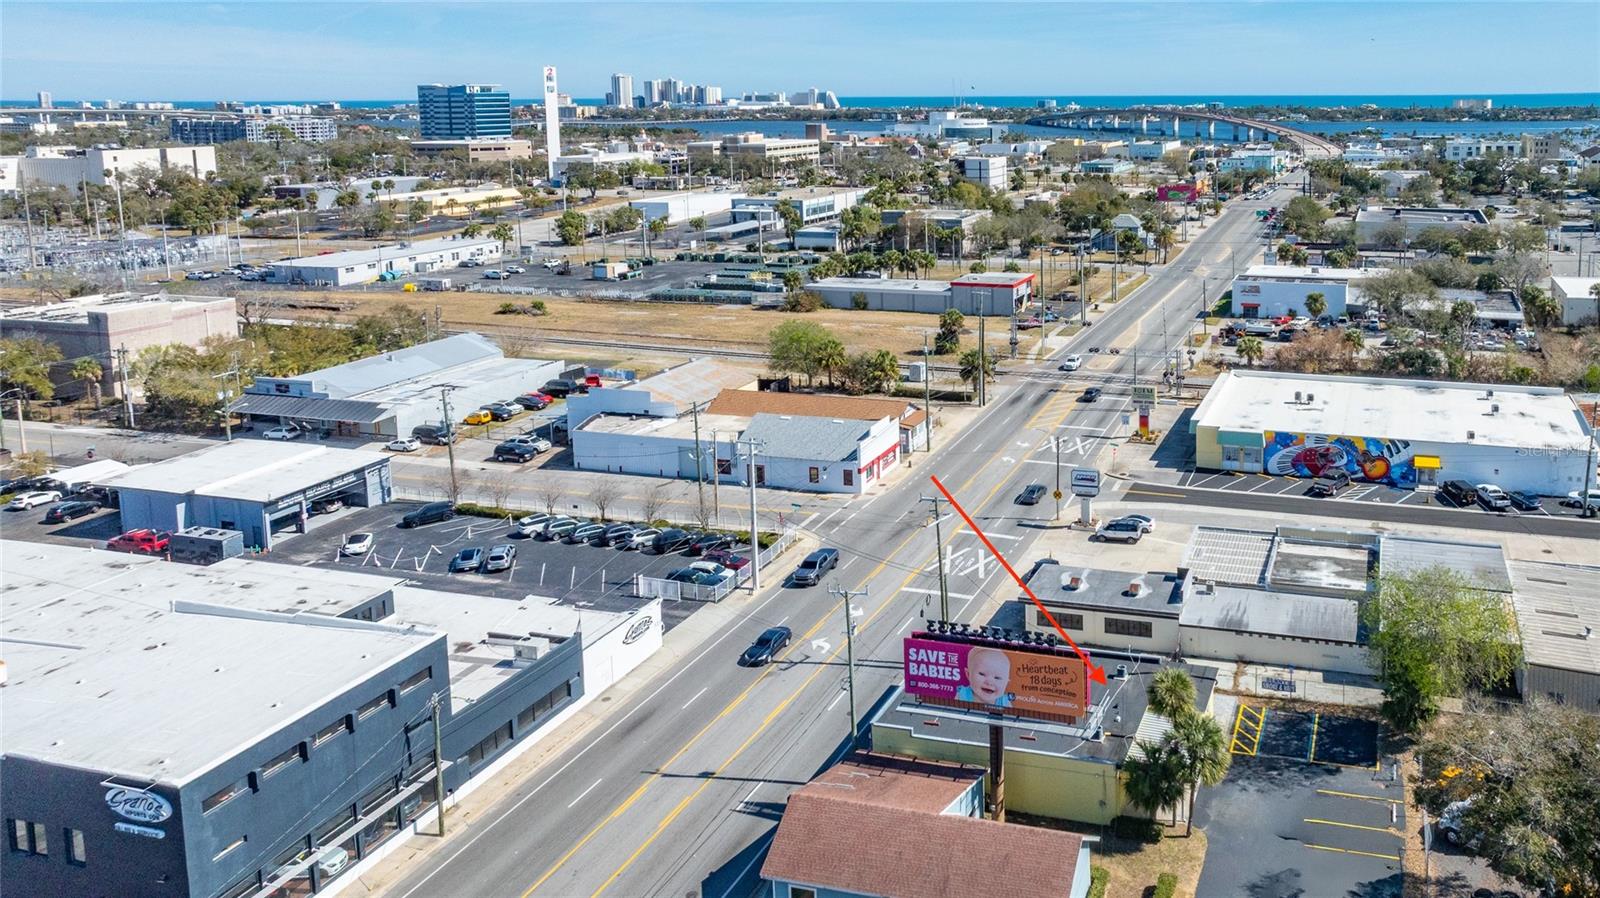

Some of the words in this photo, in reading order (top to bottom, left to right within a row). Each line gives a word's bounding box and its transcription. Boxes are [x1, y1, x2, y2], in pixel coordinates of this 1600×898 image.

[909, 647, 946, 665] SAVE
[948, 652, 958, 664] THE
[909, 661, 961, 681] BABIES
[1021, 663, 1068, 675] Heartbeat
[1029, 675, 1040, 685] 18
[1041, 675, 1062, 687] days
[1039, 686, 1077, 697] conception
